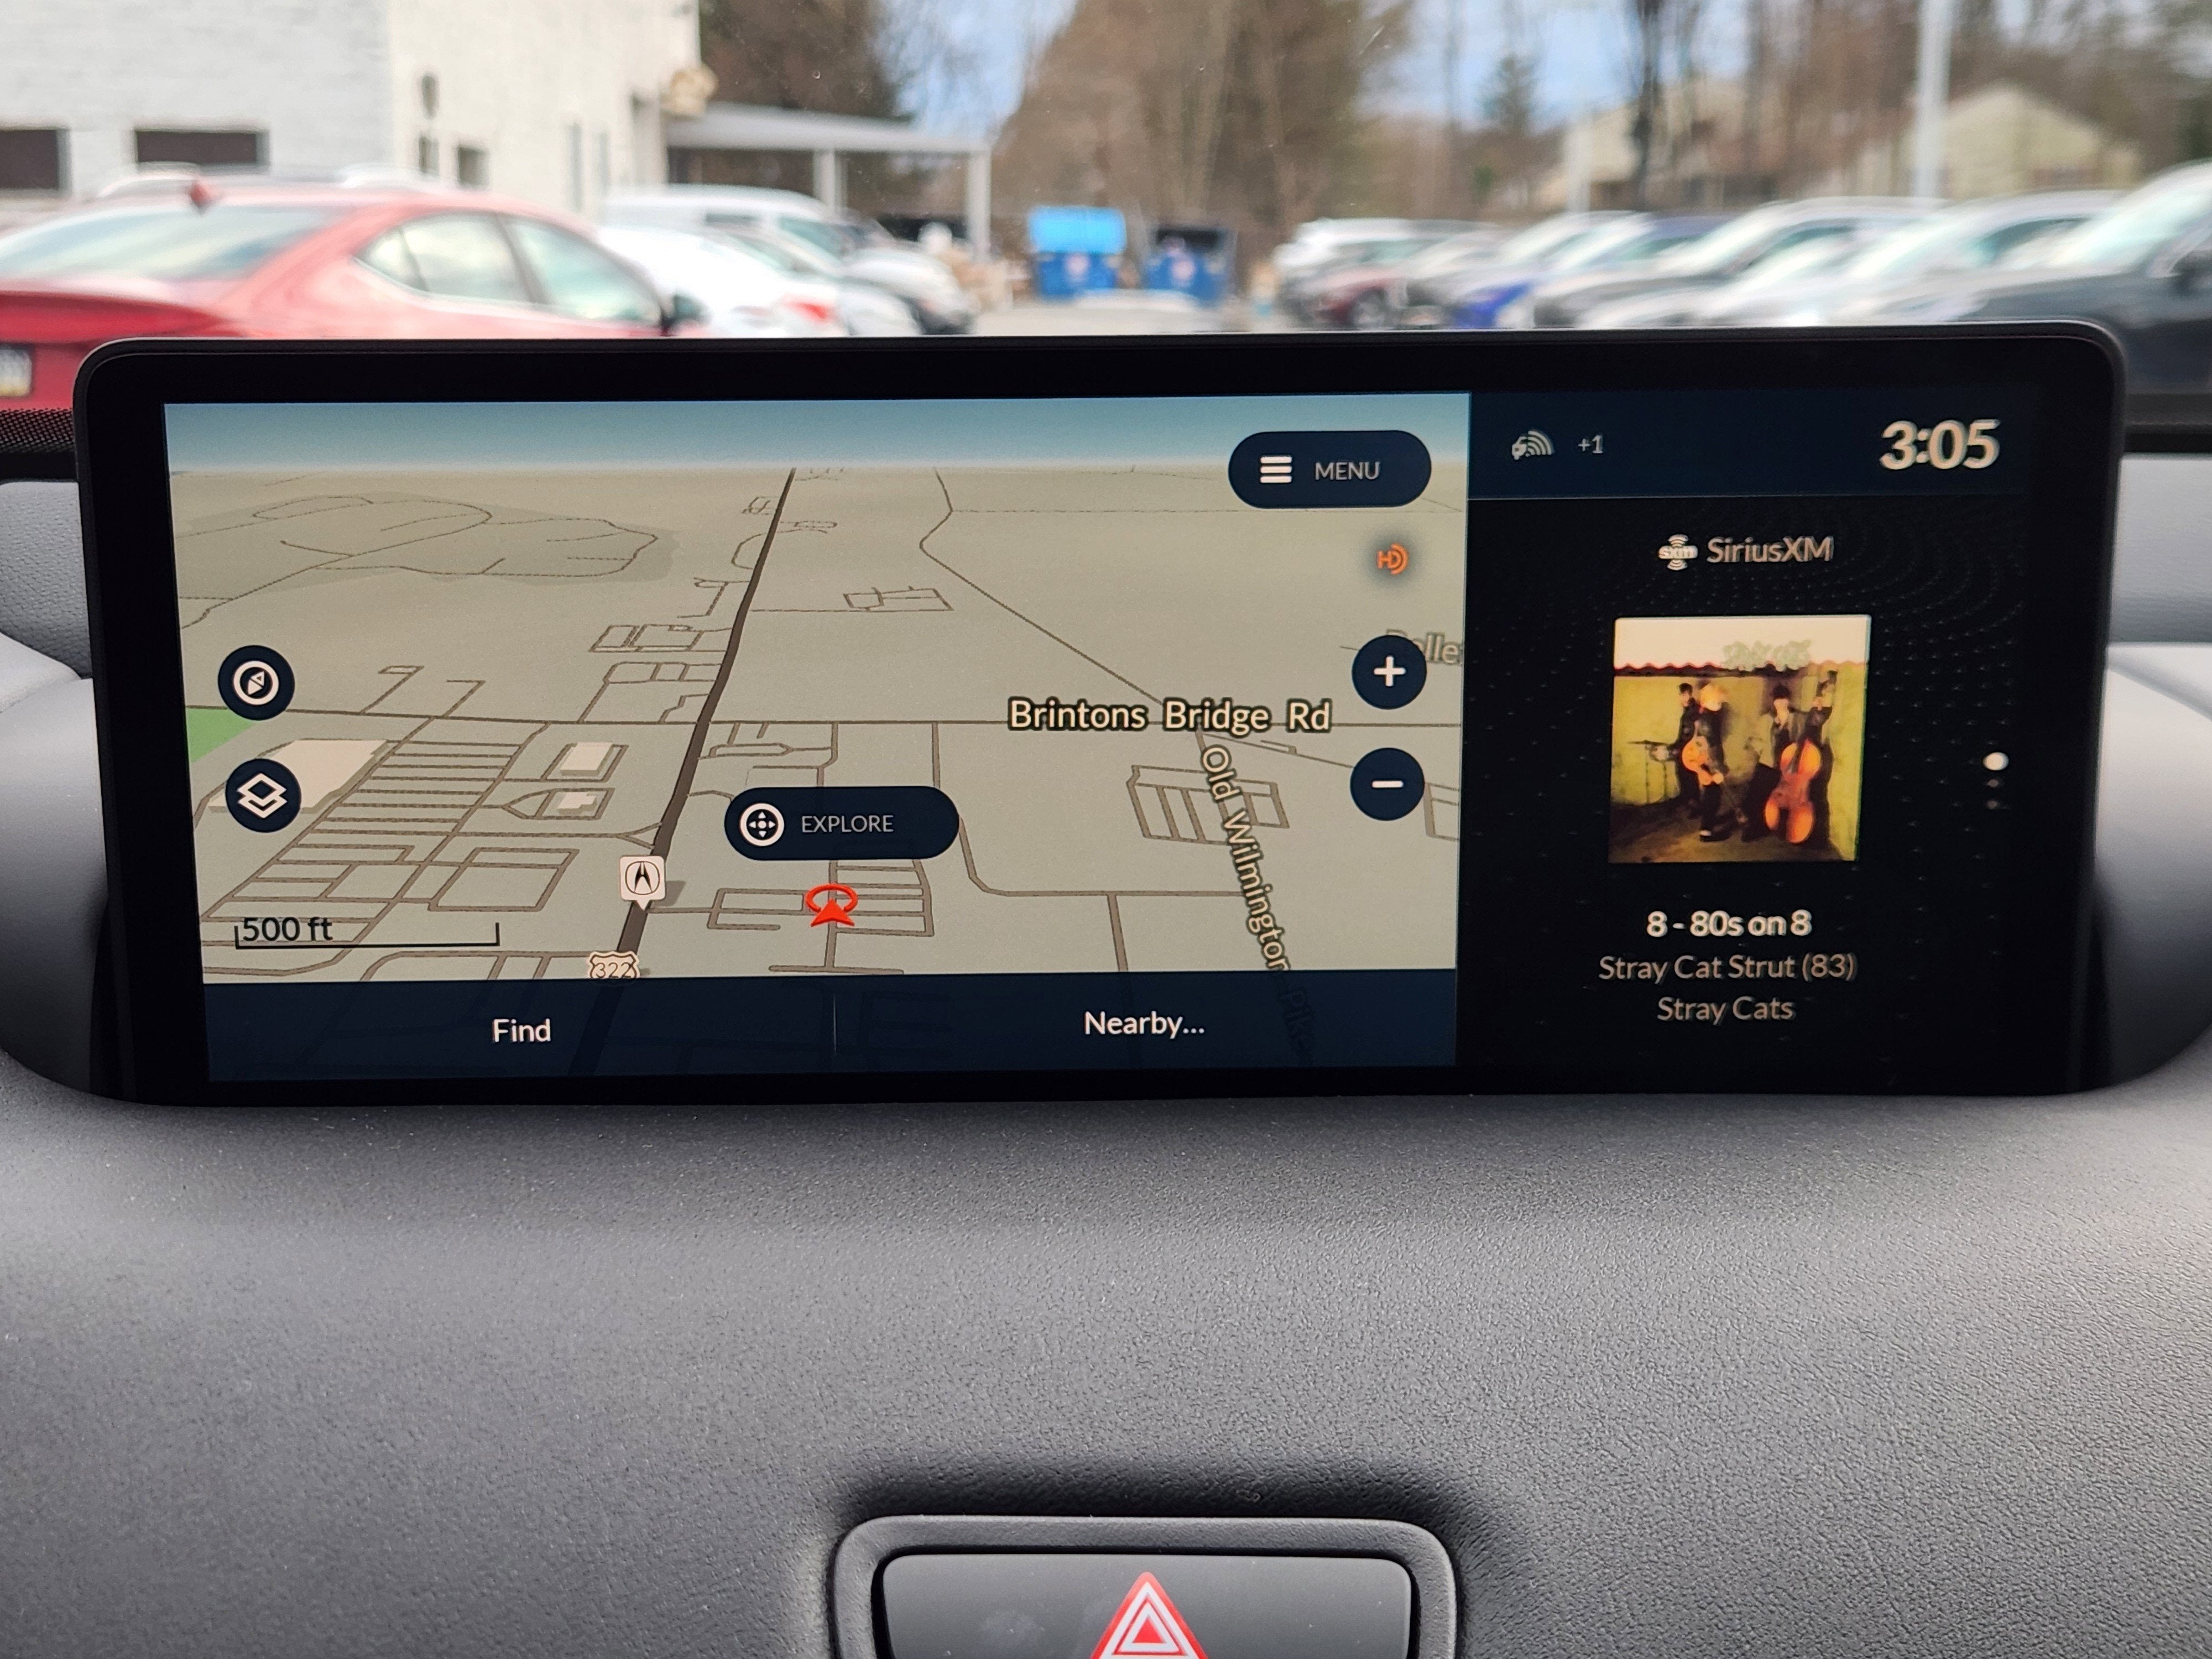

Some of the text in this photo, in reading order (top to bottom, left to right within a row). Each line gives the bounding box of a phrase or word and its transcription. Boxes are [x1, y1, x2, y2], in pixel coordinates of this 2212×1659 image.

[1578, 435, 1604, 454] +1
[1881, 419, 2000, 470] 3:05
[1315, 461, 1380, 481] MENU
[1707, 535, 1834, 563] SiriusXM
[1009, 699, 1330, 736] Brintons Bridge Rd
[1202, 747, 1240, 801] Old
[802, 815, 894, 833] EXPLORE
[243, 916, 333, 942] 500 ft
[1647, 911, 1668, 937] 8
[1689, 910, 1744, 937] 80s
[1747, 915, 1787, 936] on
[1791, 909, 1813, 936] 8
[595, 962, 633, 978] 322
[1599, 952, 1857, 984] Stray Cat Strut (83)
[1657, 995, 1796, 1025] Stray Cats
[493, 1018, 551, 1043] Find
[1084, 1010, 1205, 1040] Nearby...
